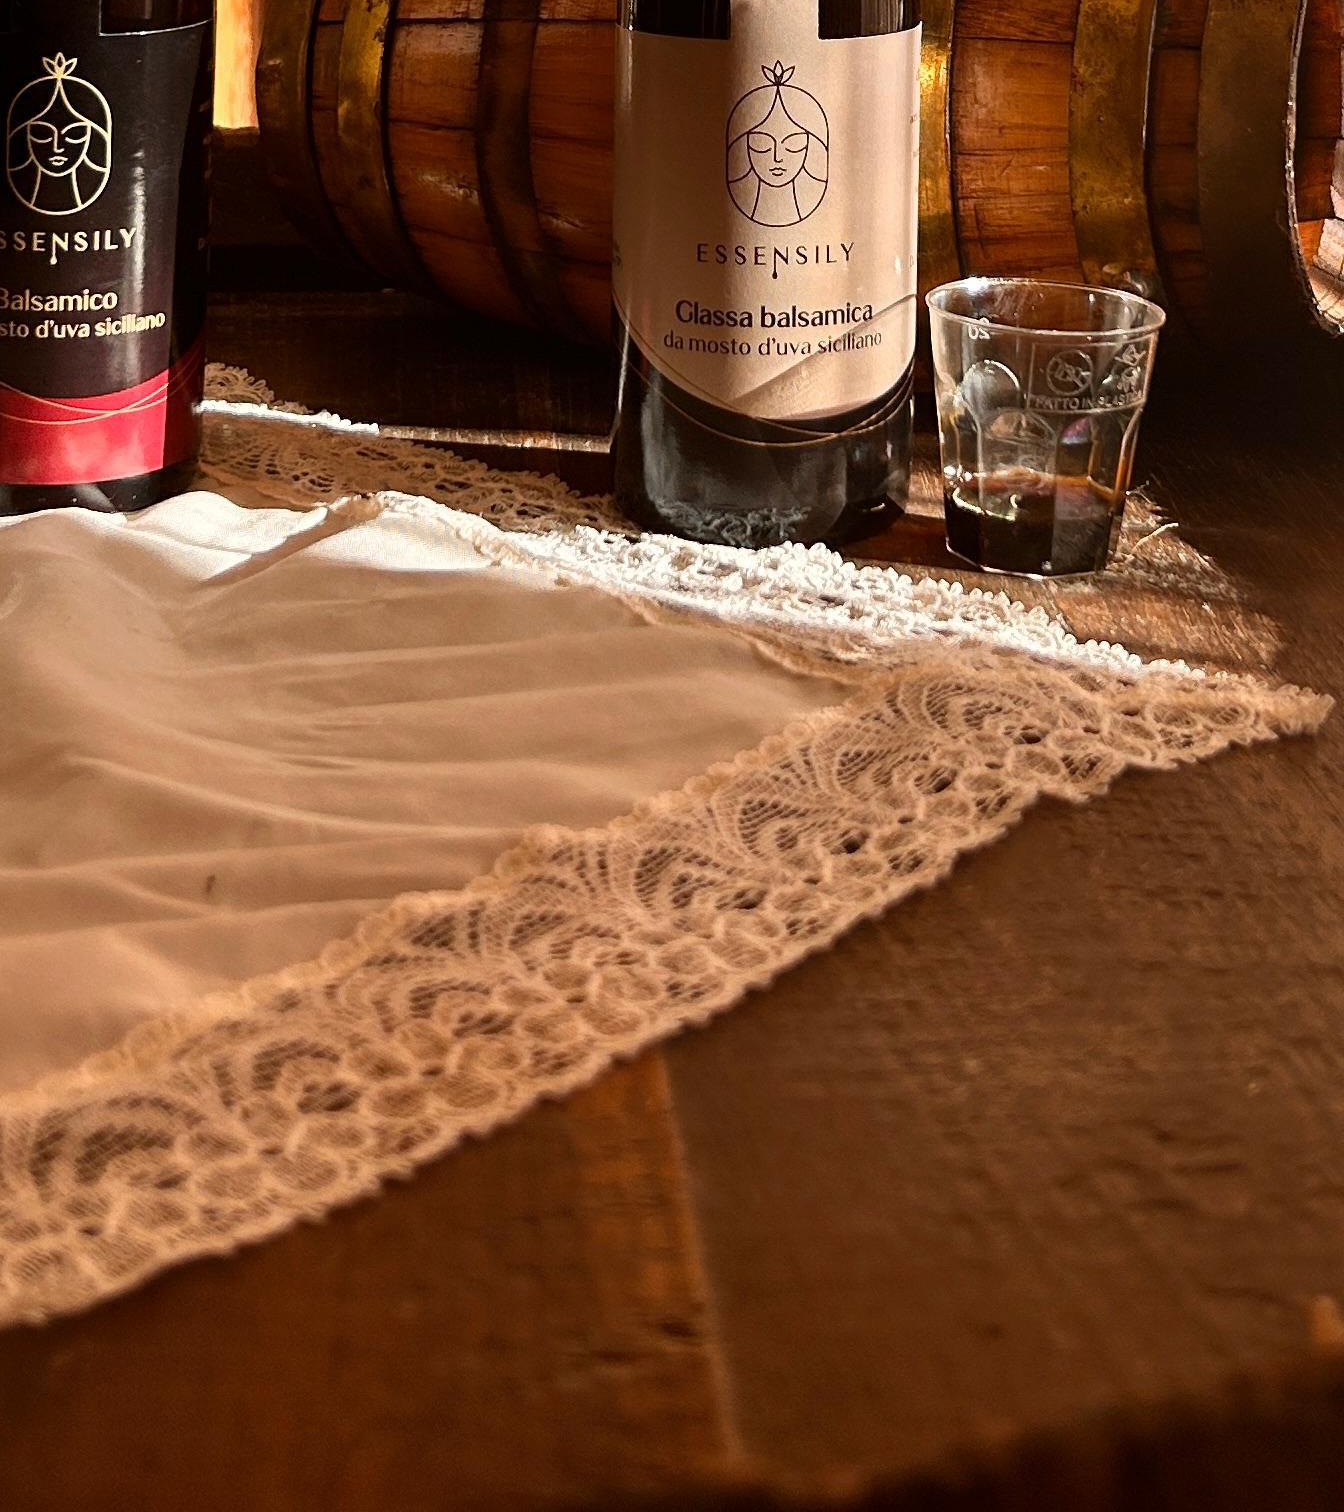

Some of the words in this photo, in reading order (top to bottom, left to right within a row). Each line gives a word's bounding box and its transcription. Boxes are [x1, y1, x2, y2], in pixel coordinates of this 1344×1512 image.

[697, 242, 854, 279] ESSENSILY
[95, 312, 166, 337] siciliano
[676, 300, 753, 327] Glassa
[760, 302, 873, 328] balsamica
[664, 330, 684, 349] da
[689, 337, 751, 355] mosto
[818, 332, 882, 353] siciliano
